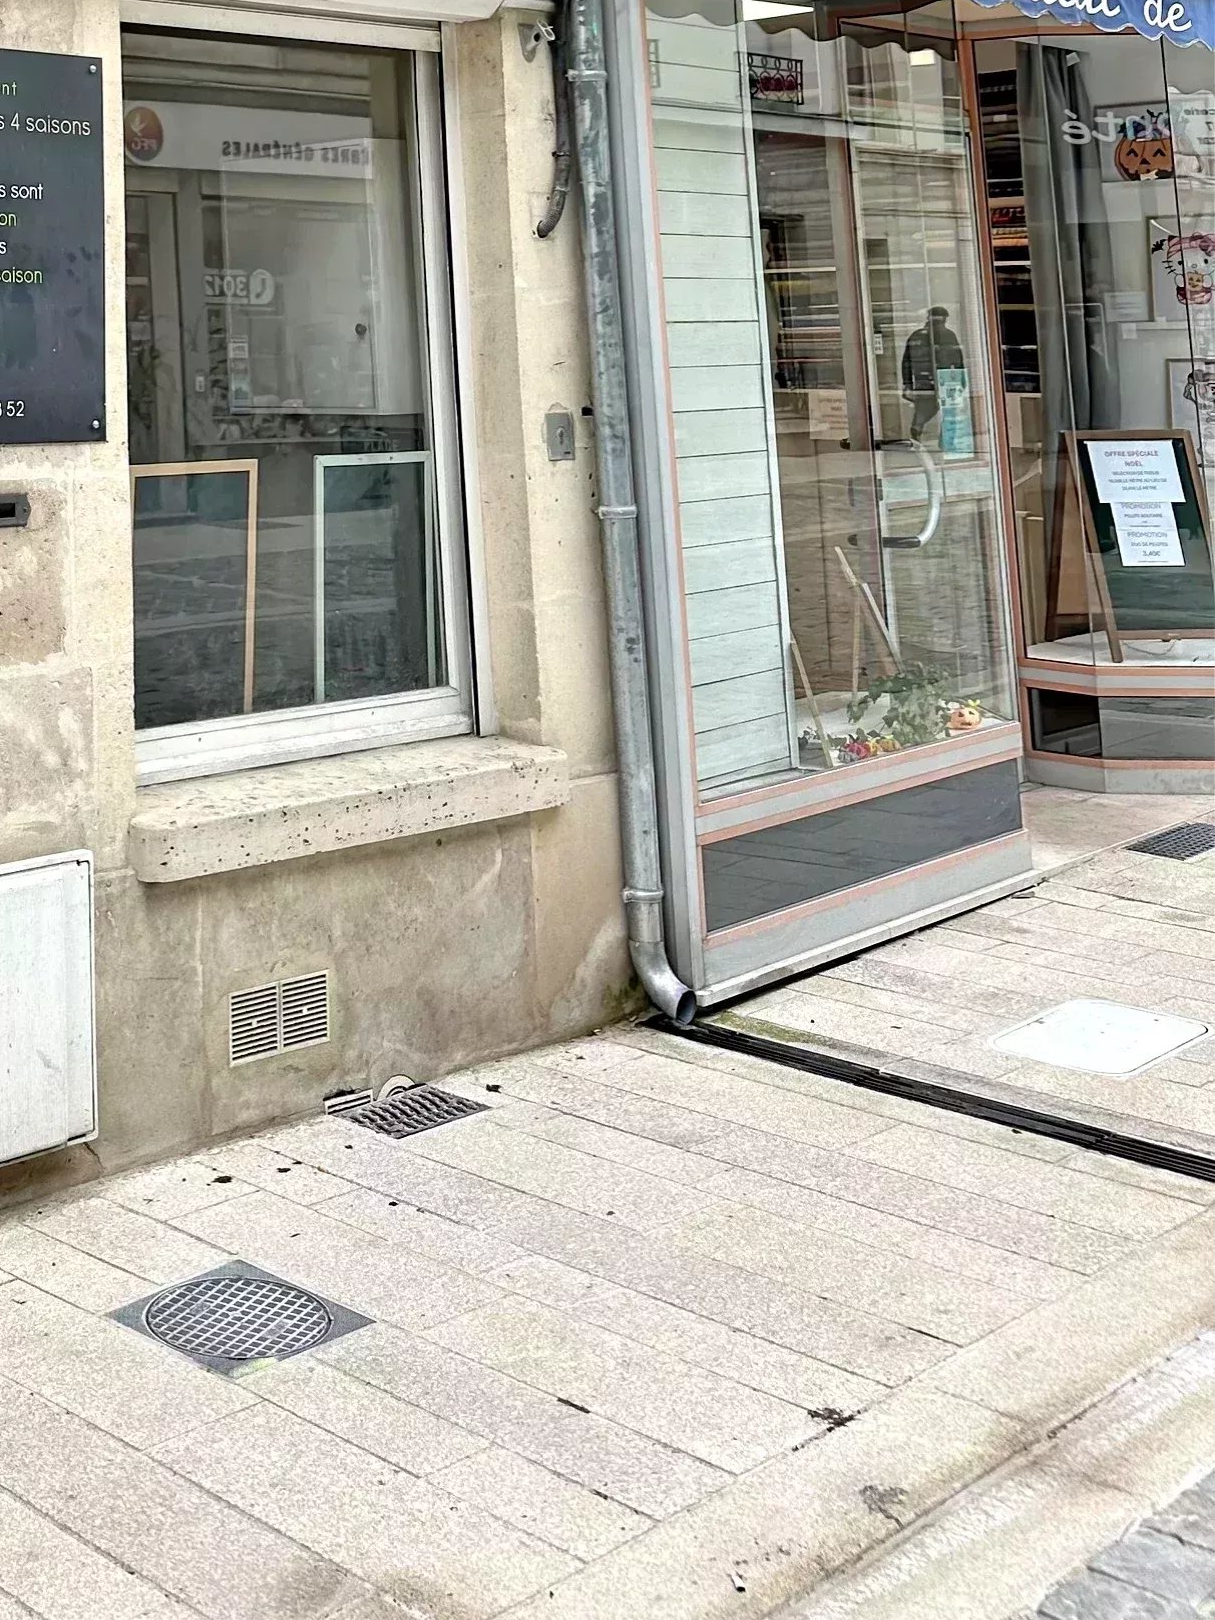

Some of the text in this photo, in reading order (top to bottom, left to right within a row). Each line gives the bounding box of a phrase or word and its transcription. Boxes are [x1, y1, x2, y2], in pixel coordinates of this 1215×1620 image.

[9, 112, 22, 132] 4
[25, 115, 92, 137] saisons
[10, 182, 44, 201] sont
[6, 400, 25, 417] 52
